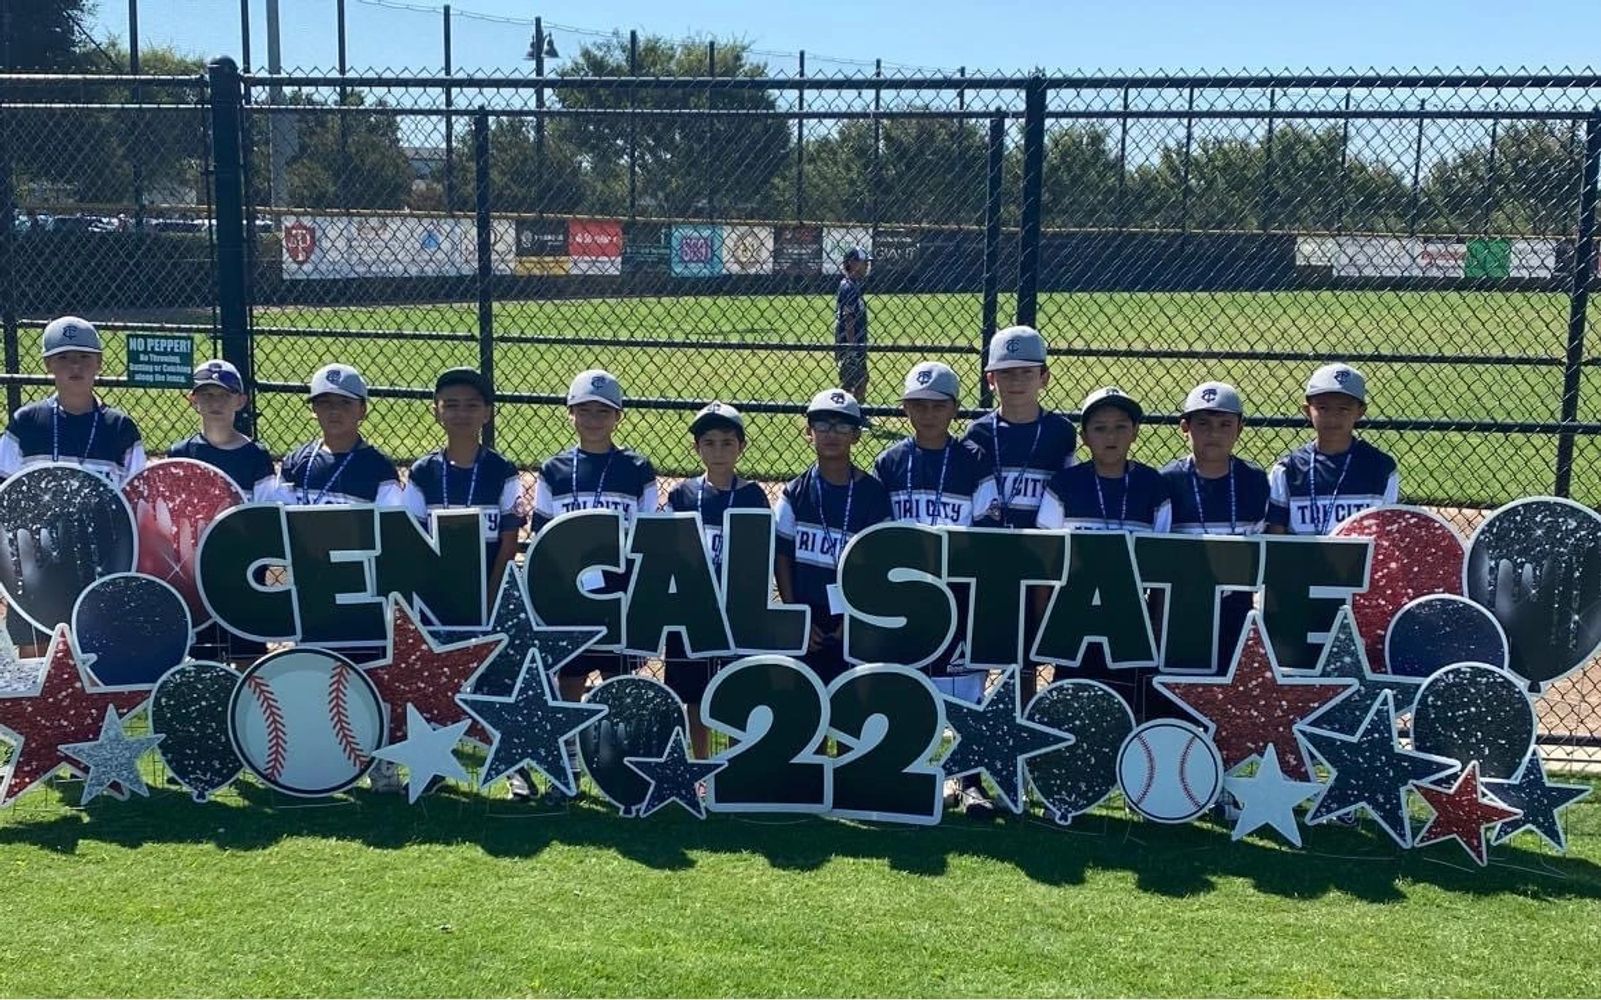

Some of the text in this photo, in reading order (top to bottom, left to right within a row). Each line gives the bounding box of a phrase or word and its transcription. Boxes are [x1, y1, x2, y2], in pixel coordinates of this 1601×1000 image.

[129, 337, 191, 353] NO PEPPER!
[155, 374, 166, 382] the
[195, 504, 1374, 676] CEN CAL STATE
[701, 655, 946, 826] 22
